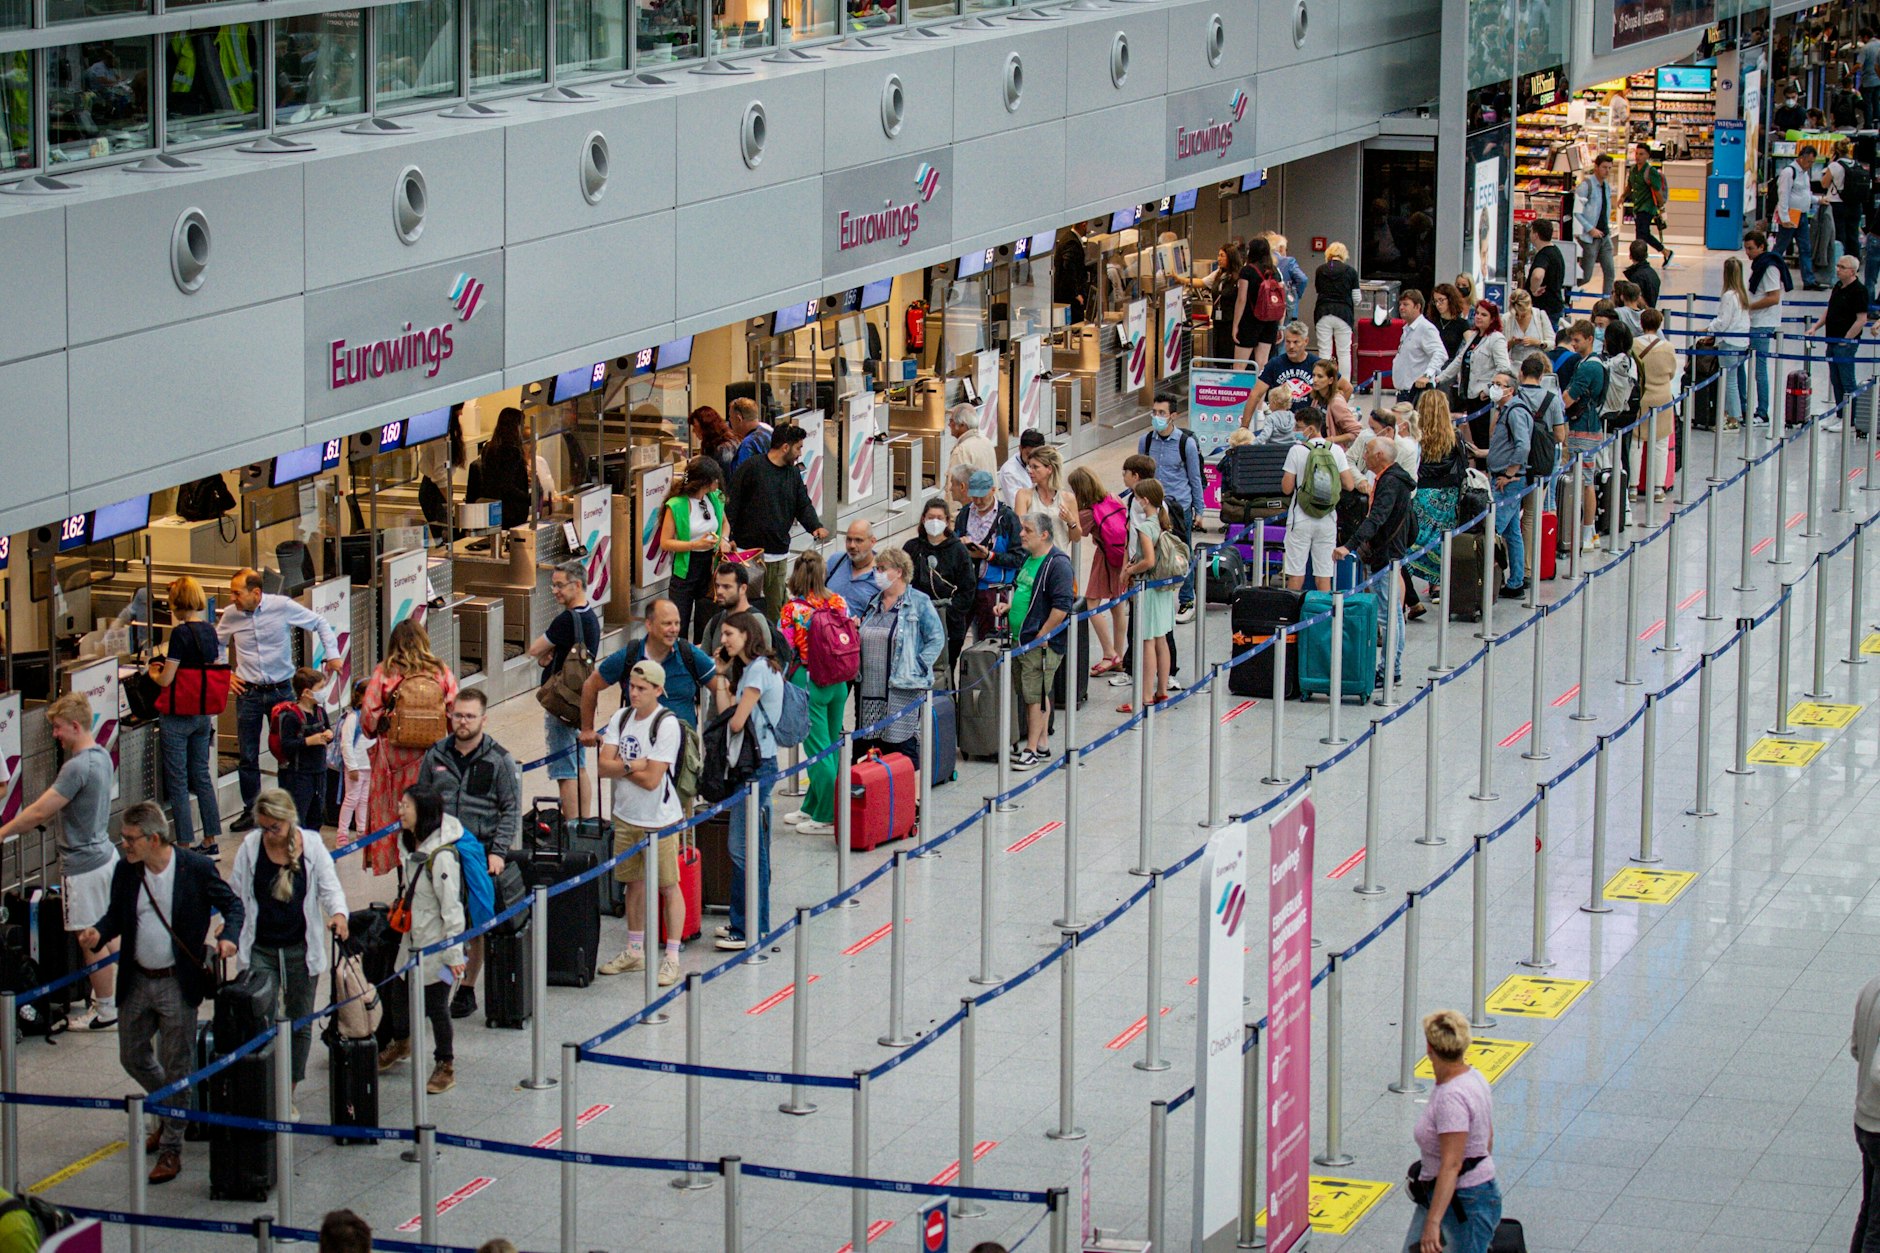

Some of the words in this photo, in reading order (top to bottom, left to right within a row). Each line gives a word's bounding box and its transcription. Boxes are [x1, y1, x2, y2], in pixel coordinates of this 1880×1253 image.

[1531, 71, 1556, 96] WHSmith
[1717, 120, 1744, 129] WHSmith
[1177, 118, 1233, 160] Eurowings
[839, 199, 919, 251] Eurowings
[1015, 237, 1027, 255] 154
[844, 289, 858, 306] 156
[330, 321, 454, 390] Eurowings
[636, 348, 652, 369] 158
[1198, 387, 1218, 396] GEPÄCK
[381, 422, 401, 445] 160
[323, 438, 340, 462] 61
[61, 514, 86, 541] 162
[394, 573, 417, 588] Eurowings
[1272, 847, 1300, 886] Eurowings
[1210, 1028, 1240, 1057] Check-in
[661, 1063, 676, 1073] DUS
[767, 1074, 782, 1083] DUS
[95, 1099, 111, 1108] DUS
[170, 1108, 186, 1118] DUS
[277, 1123, 293, 1132] DUS
[384, 1130, 400, 1139] DUS
[466, 1138, 482, 1148] DUS
[576, 1153, 592, 1163] DUS
[687, 1161, 704, 1171] DUS
[779, 1169, 796, 1180] DUS
[895, 1182, 912, 1193] DUS
[1013, 1192, 1030, 1201] DUS
[110, 1213, 125, 1223] DUS
[221, 1223, 238, 1233] DUS
